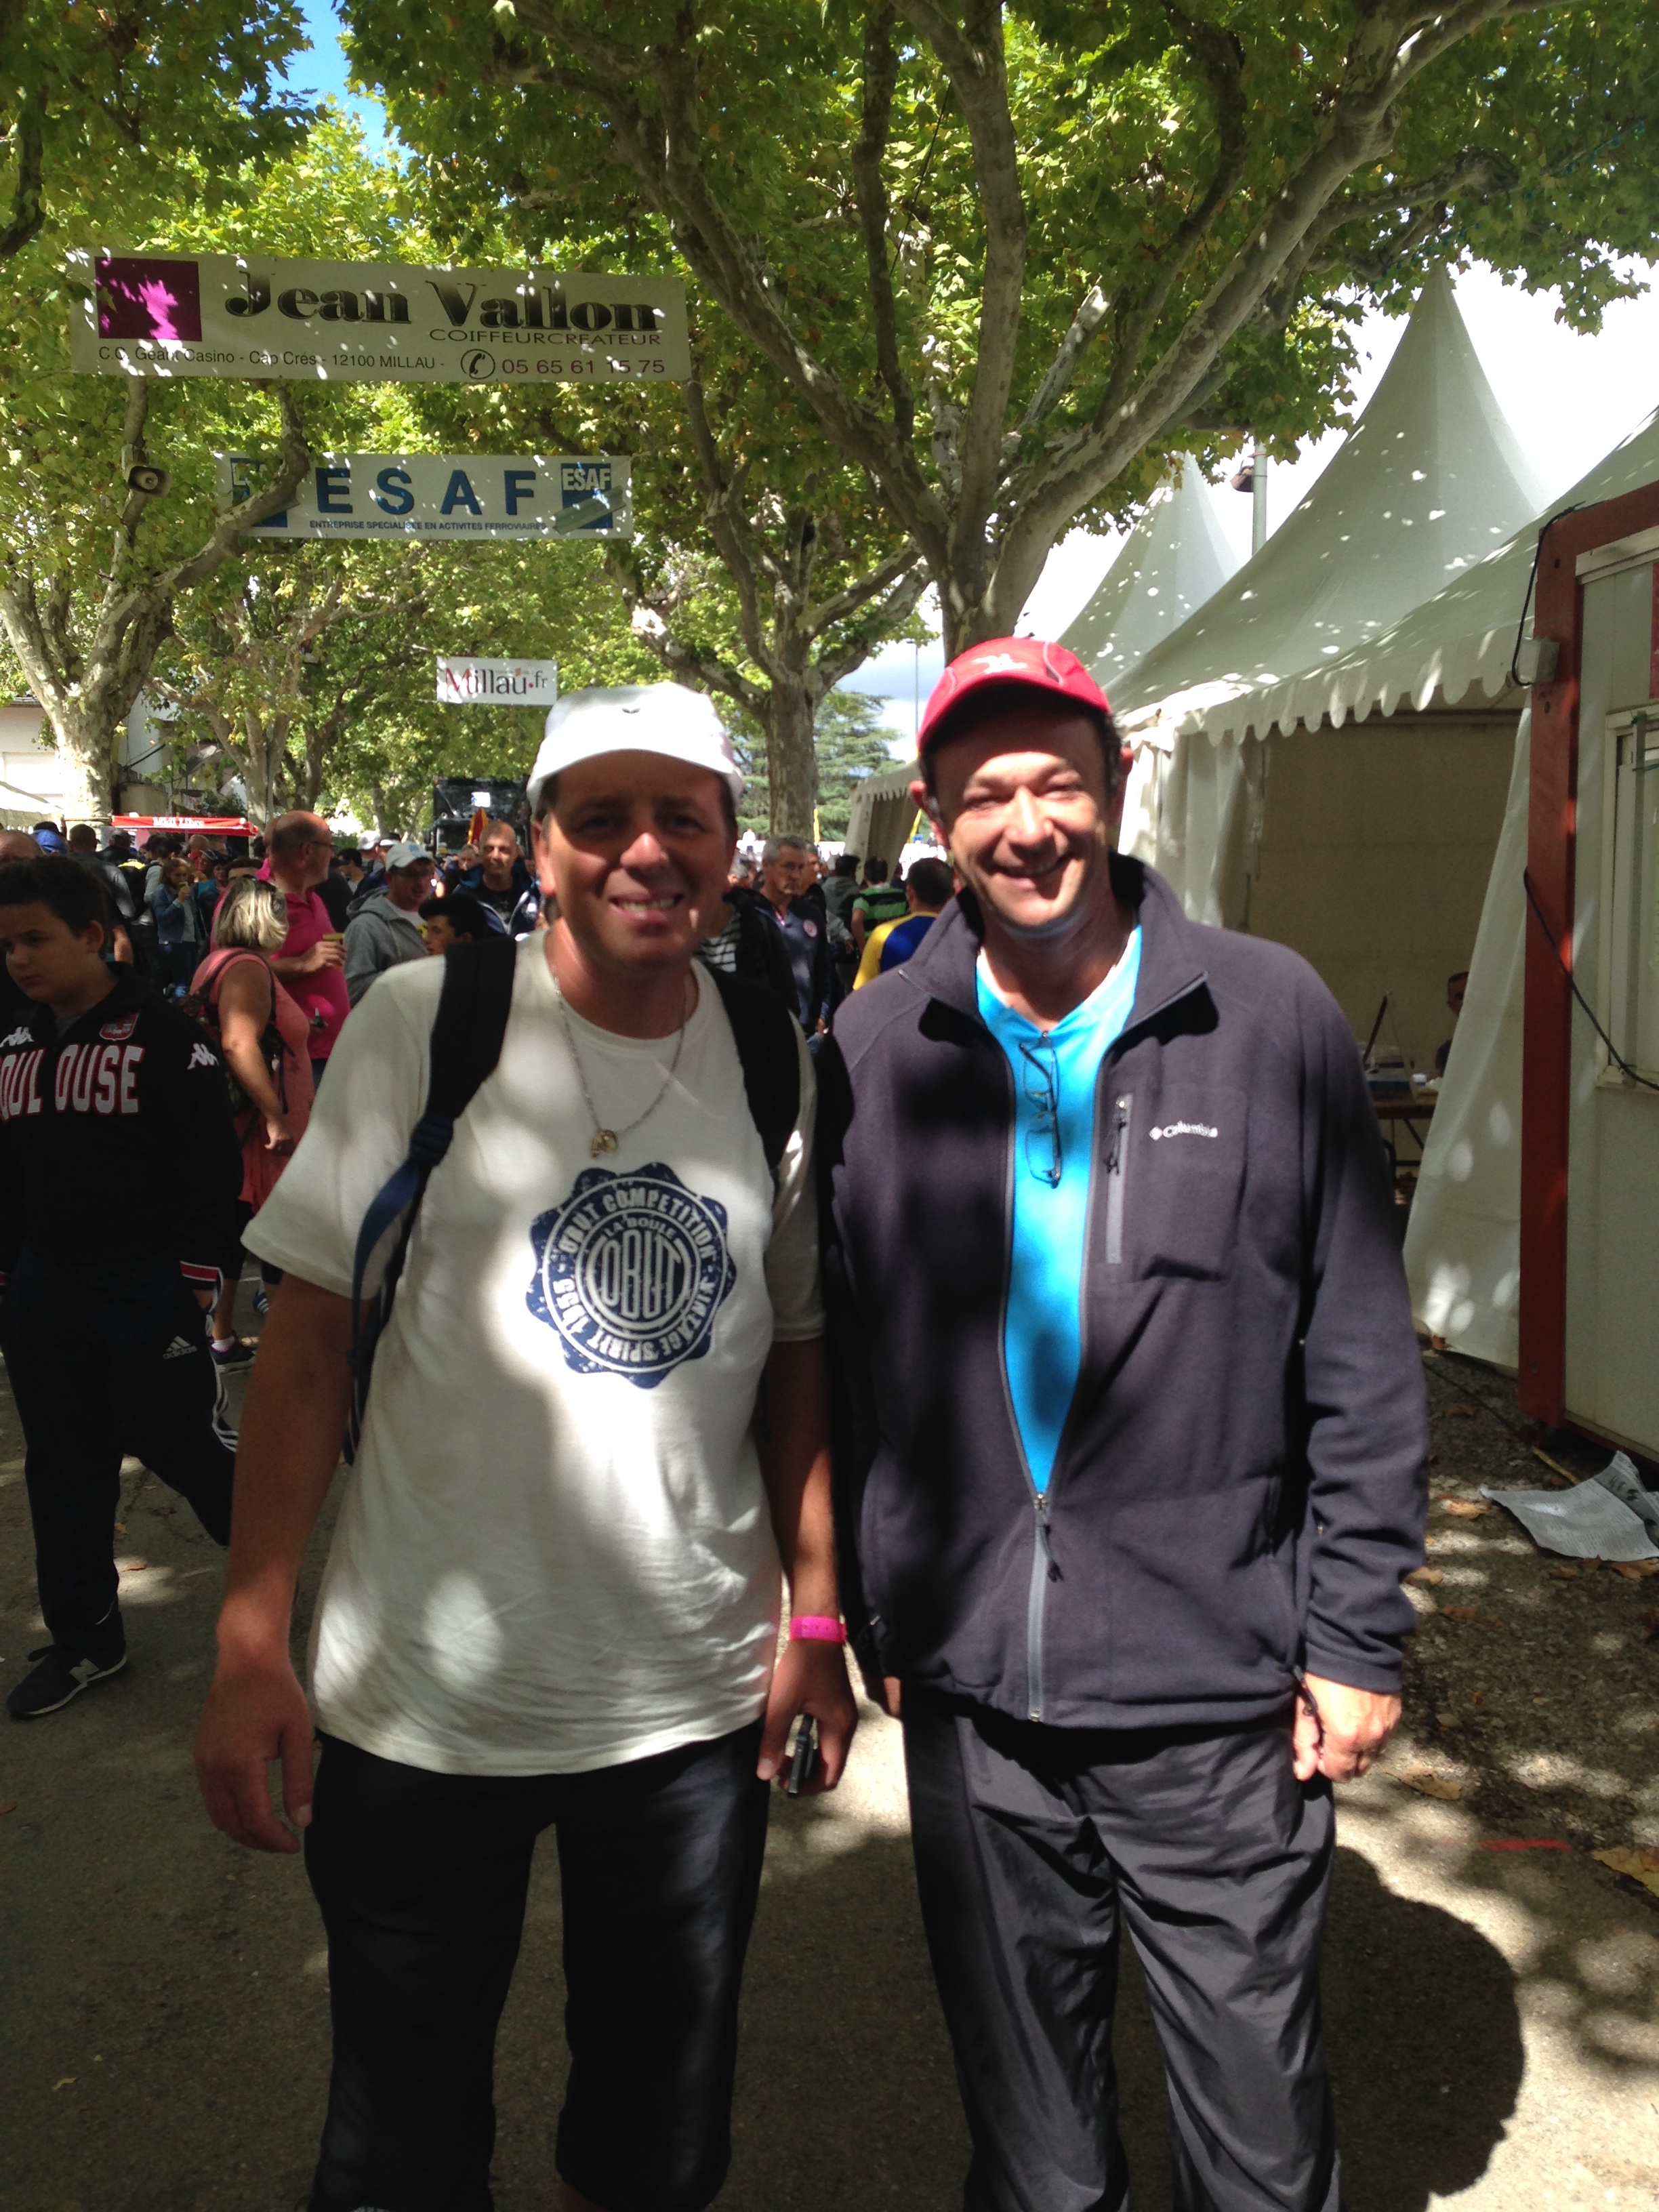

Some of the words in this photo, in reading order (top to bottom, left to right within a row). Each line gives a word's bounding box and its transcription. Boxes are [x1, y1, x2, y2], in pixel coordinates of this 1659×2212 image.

[224, 270, 412, 325] Jean
[424, 280, 661, 332] Vallon
[184, 348, 234, 363] Casino
[249, 350, 278, 367] Cap
[332, 354, 375, 367] 12100
[380, 355, 436, 369] MILLAU
[501, 359, 529, 374] 05
[536, 359, 563, 375] 65
[570, 360, 594, 375] 61
[638, 359, 665, 374] 75
[562, 468, 612, 491] ESAF
[310, 520, 365, 529] ENTREPRISE
[424, 522, 437, 530] EN
[556, 1202, 601, 1254] OBUT
[601, 1187, 718, 1260] COMPETITION
[603, 1221, 625, 1237] LA
[626, 1217, 677, 1240] BOULE
[586, 1326, 662, 1364] SPIRIT
